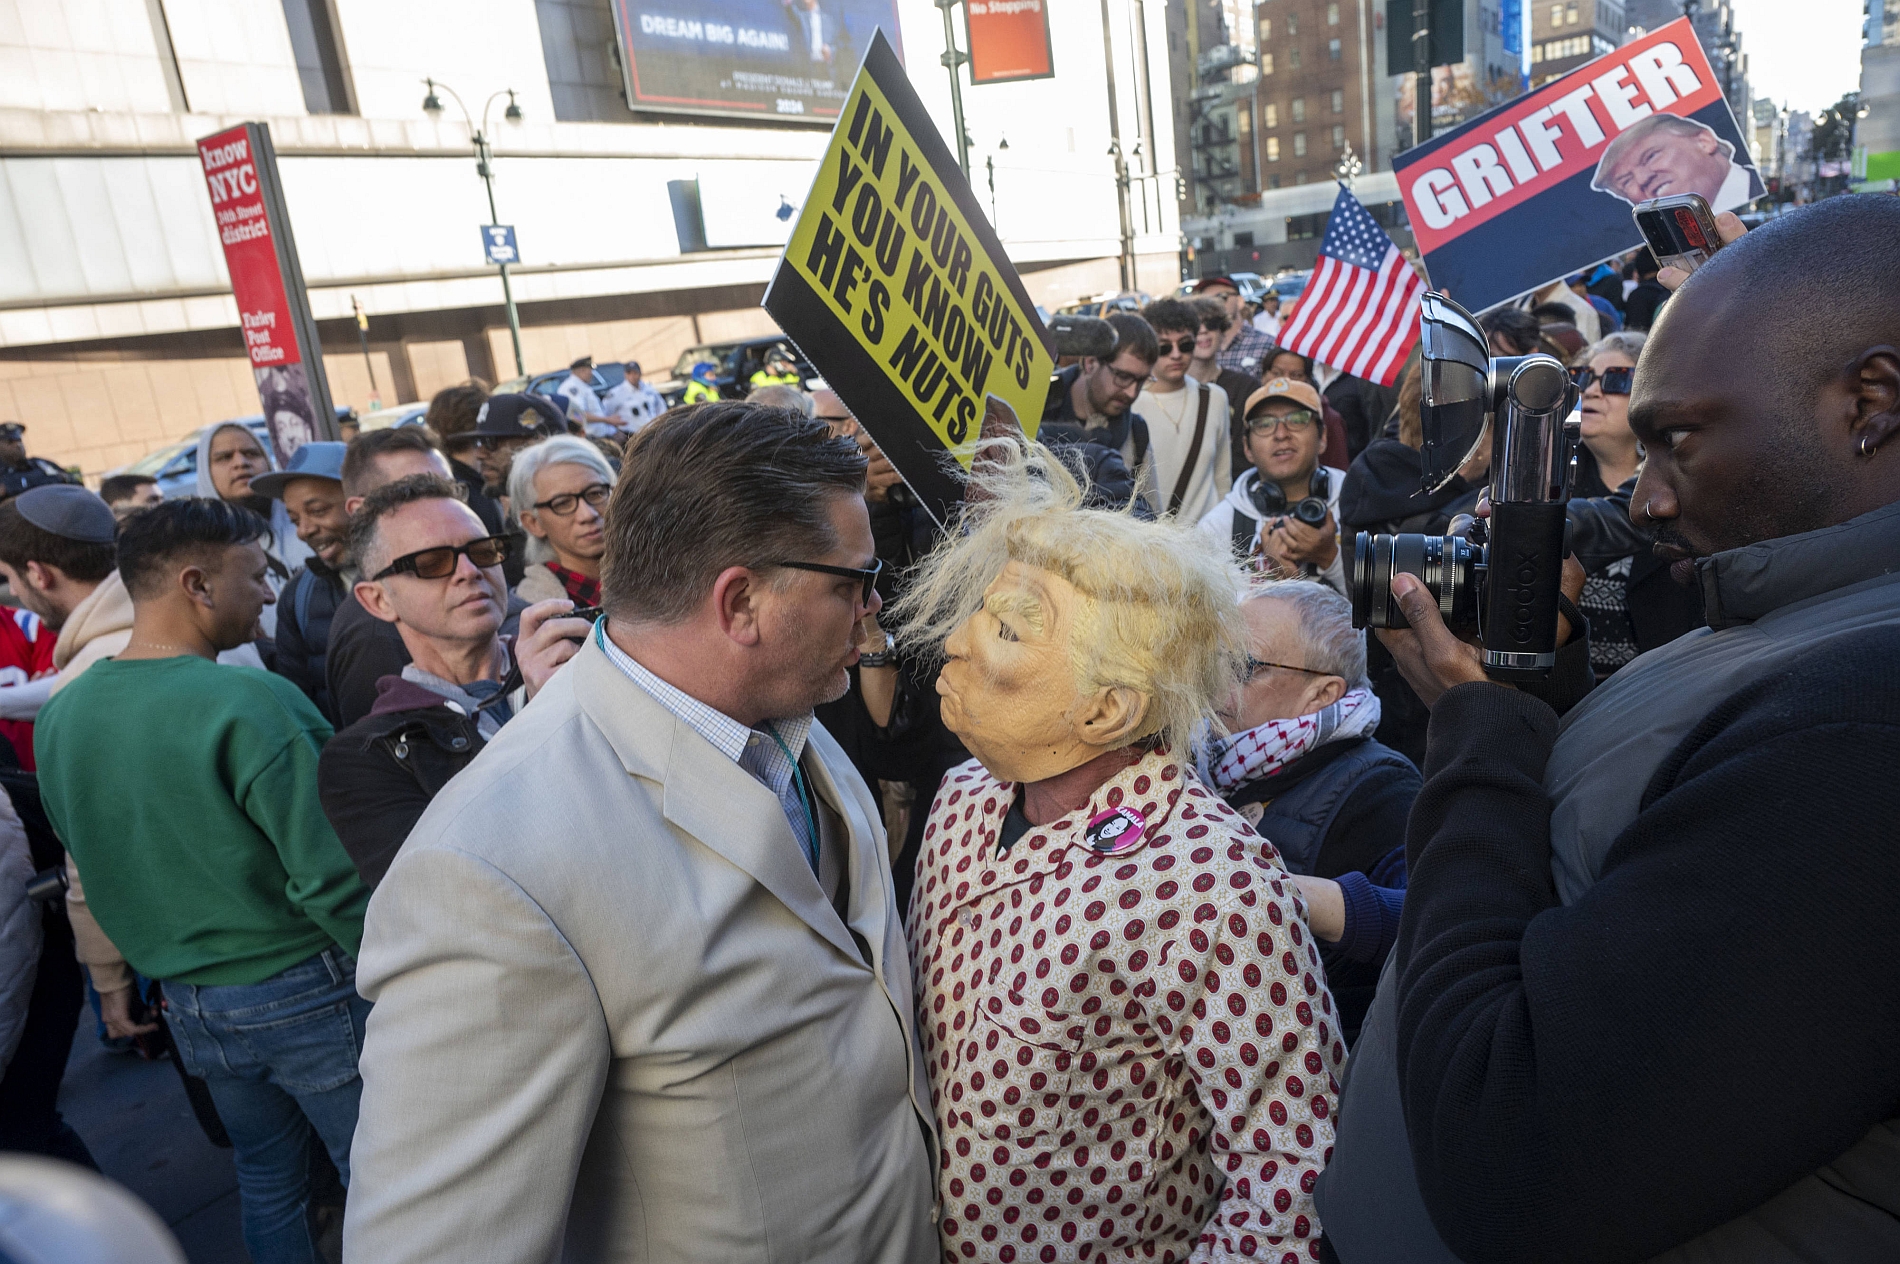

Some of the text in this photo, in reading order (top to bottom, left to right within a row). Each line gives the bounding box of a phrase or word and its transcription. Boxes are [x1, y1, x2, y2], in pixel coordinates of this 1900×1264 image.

[969, 0, 1040, 15] No Stopping
[640, 14, 790, 50] DREAM BIG AGAIN!
[1411, 41, 1703, 230] GRIFTER
[201, 139, 247, 171] know
[208, 163, 257, 204] NYC
[222, 217, 269, 245] district
[847, 89, 1034, 390] IN YOUR GUTS
[832, 146, 993, 399] YOU KNOW
[247, 328, 272, 346] Post
[806, 212, 976, 445] HE'S NUTS
[251, 345, 285, 362] Office
[1115, 806, 1144, 829] KAMALA
